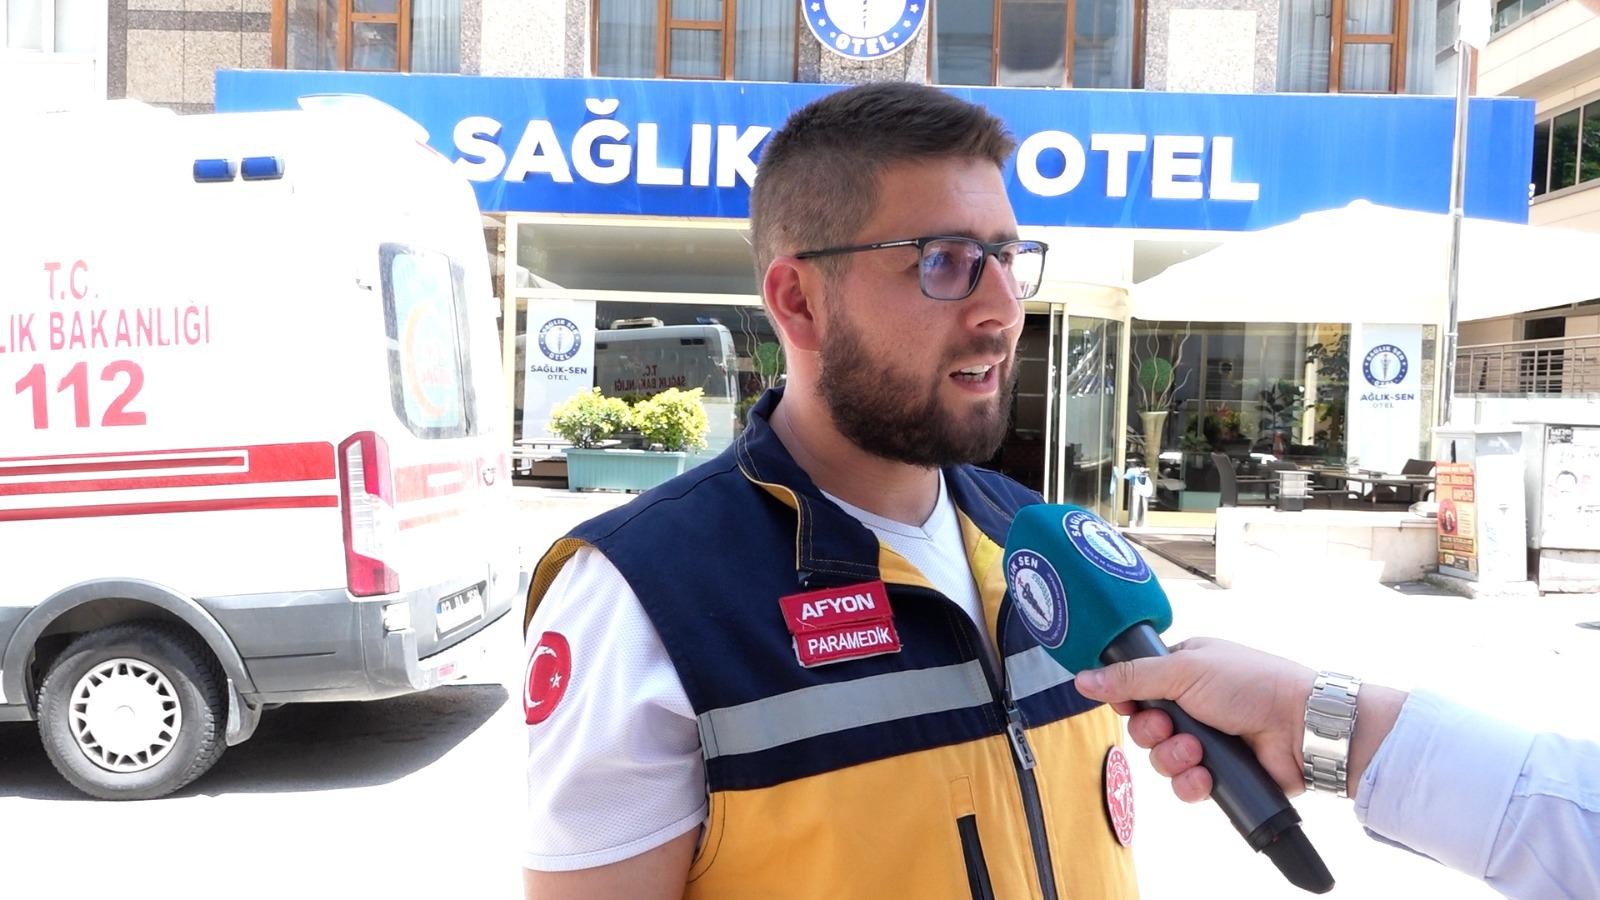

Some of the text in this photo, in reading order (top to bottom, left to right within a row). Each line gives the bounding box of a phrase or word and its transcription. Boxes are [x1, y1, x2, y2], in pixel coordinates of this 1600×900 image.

[835, 33, 896, 55] OTEL
[452, 97, 1260, 202] SAĞLIK OTEL
[44, 259, 98, 300] T.C.
[530, 363, 588, 375] SAĞLIK-SEN
[15, 359, 147, 430] 112
[1018, 556, 1038, 569] SEN
[801, 592, 876, 621] AFYON
[807, 626, 894, 656] PARAMEDİK
